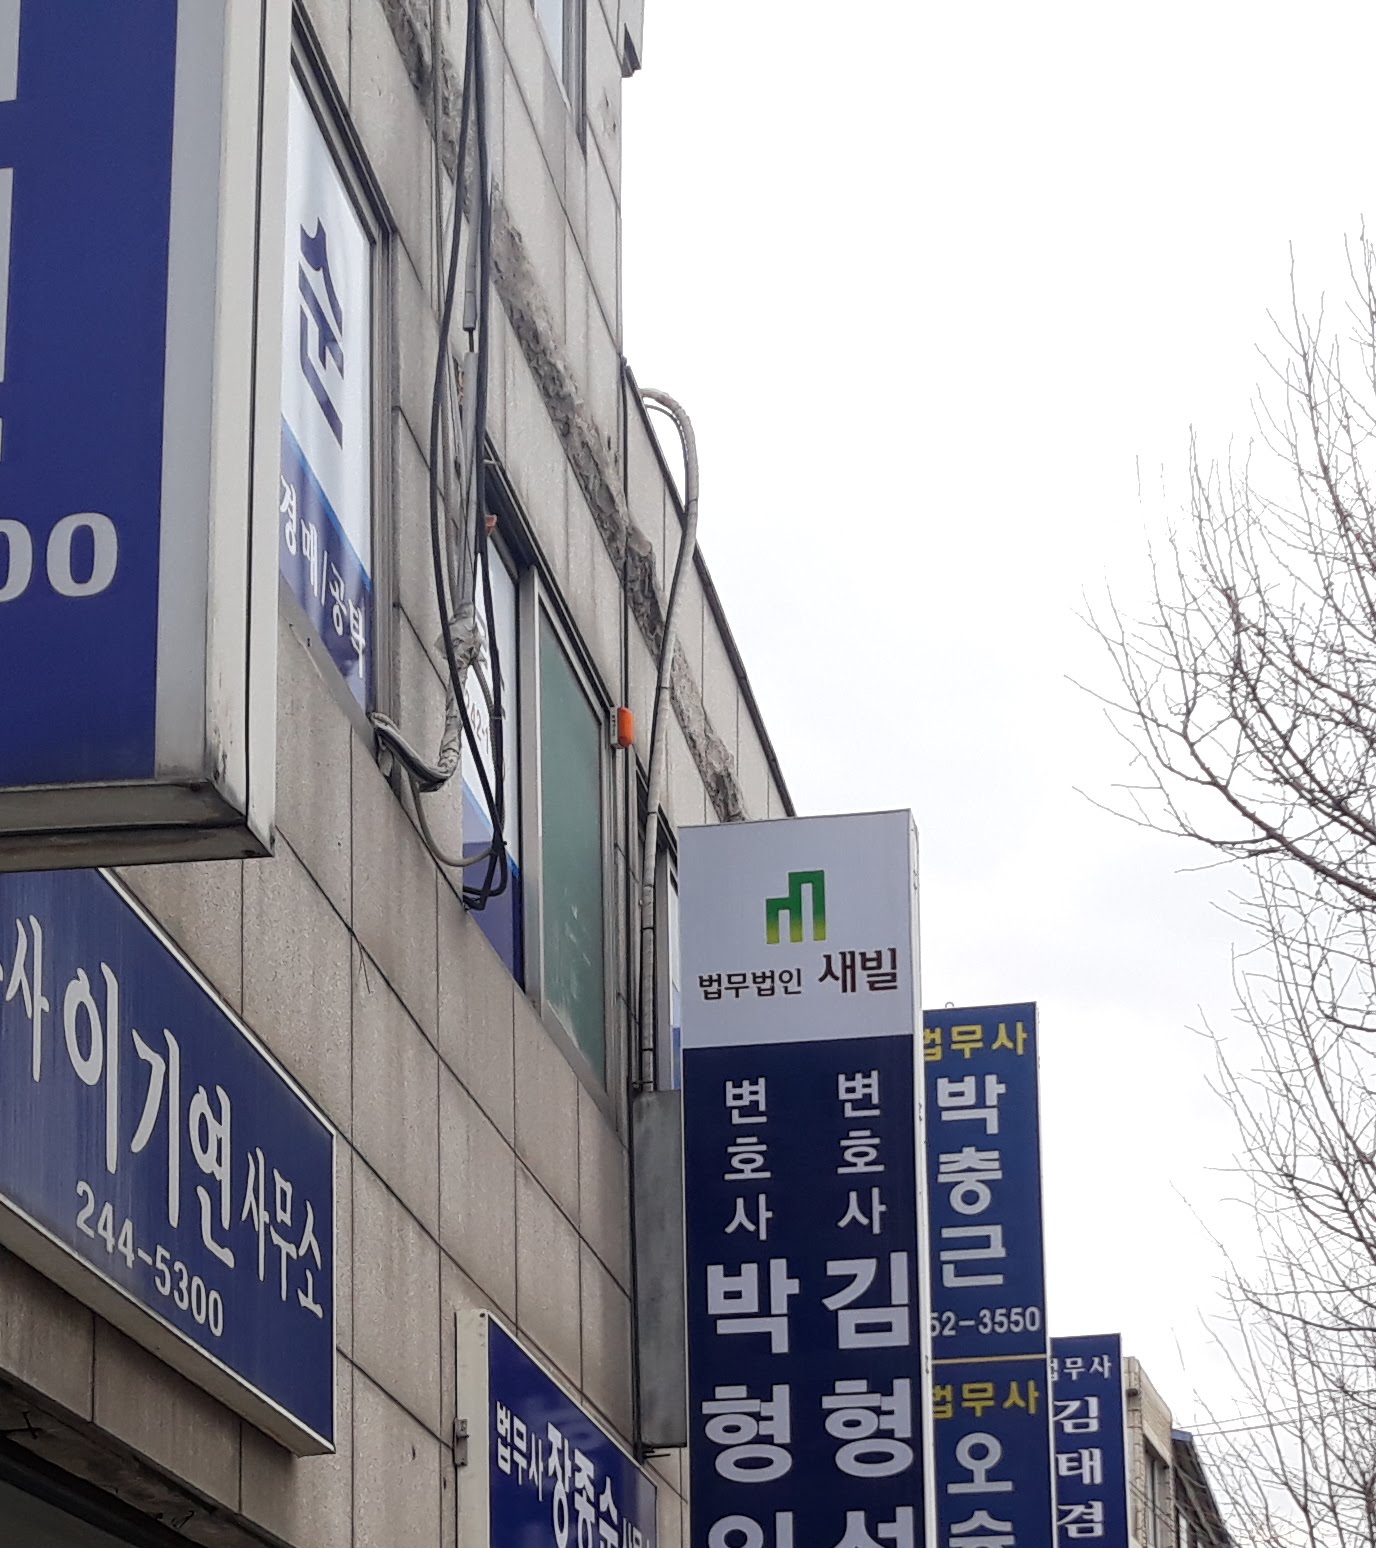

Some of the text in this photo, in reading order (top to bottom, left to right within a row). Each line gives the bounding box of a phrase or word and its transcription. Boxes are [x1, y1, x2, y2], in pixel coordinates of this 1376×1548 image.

[698, 946, 898, 1000] 법무법인 새빌
[64, 962, 234, 1268] 이기연
[241, 1146, 324, 1320] 사무소
[724, 1075, 774, 1241] 변호사
[835, 1068, 888, 1236] 변호사
[936, 1073, 1007, 1289] 박충근
[75, 1179, 224, 1338] 244-5300
[496, 1400, 545, 1502] 법무사
[1052, 1395, 1105, 1539] 김태겸
